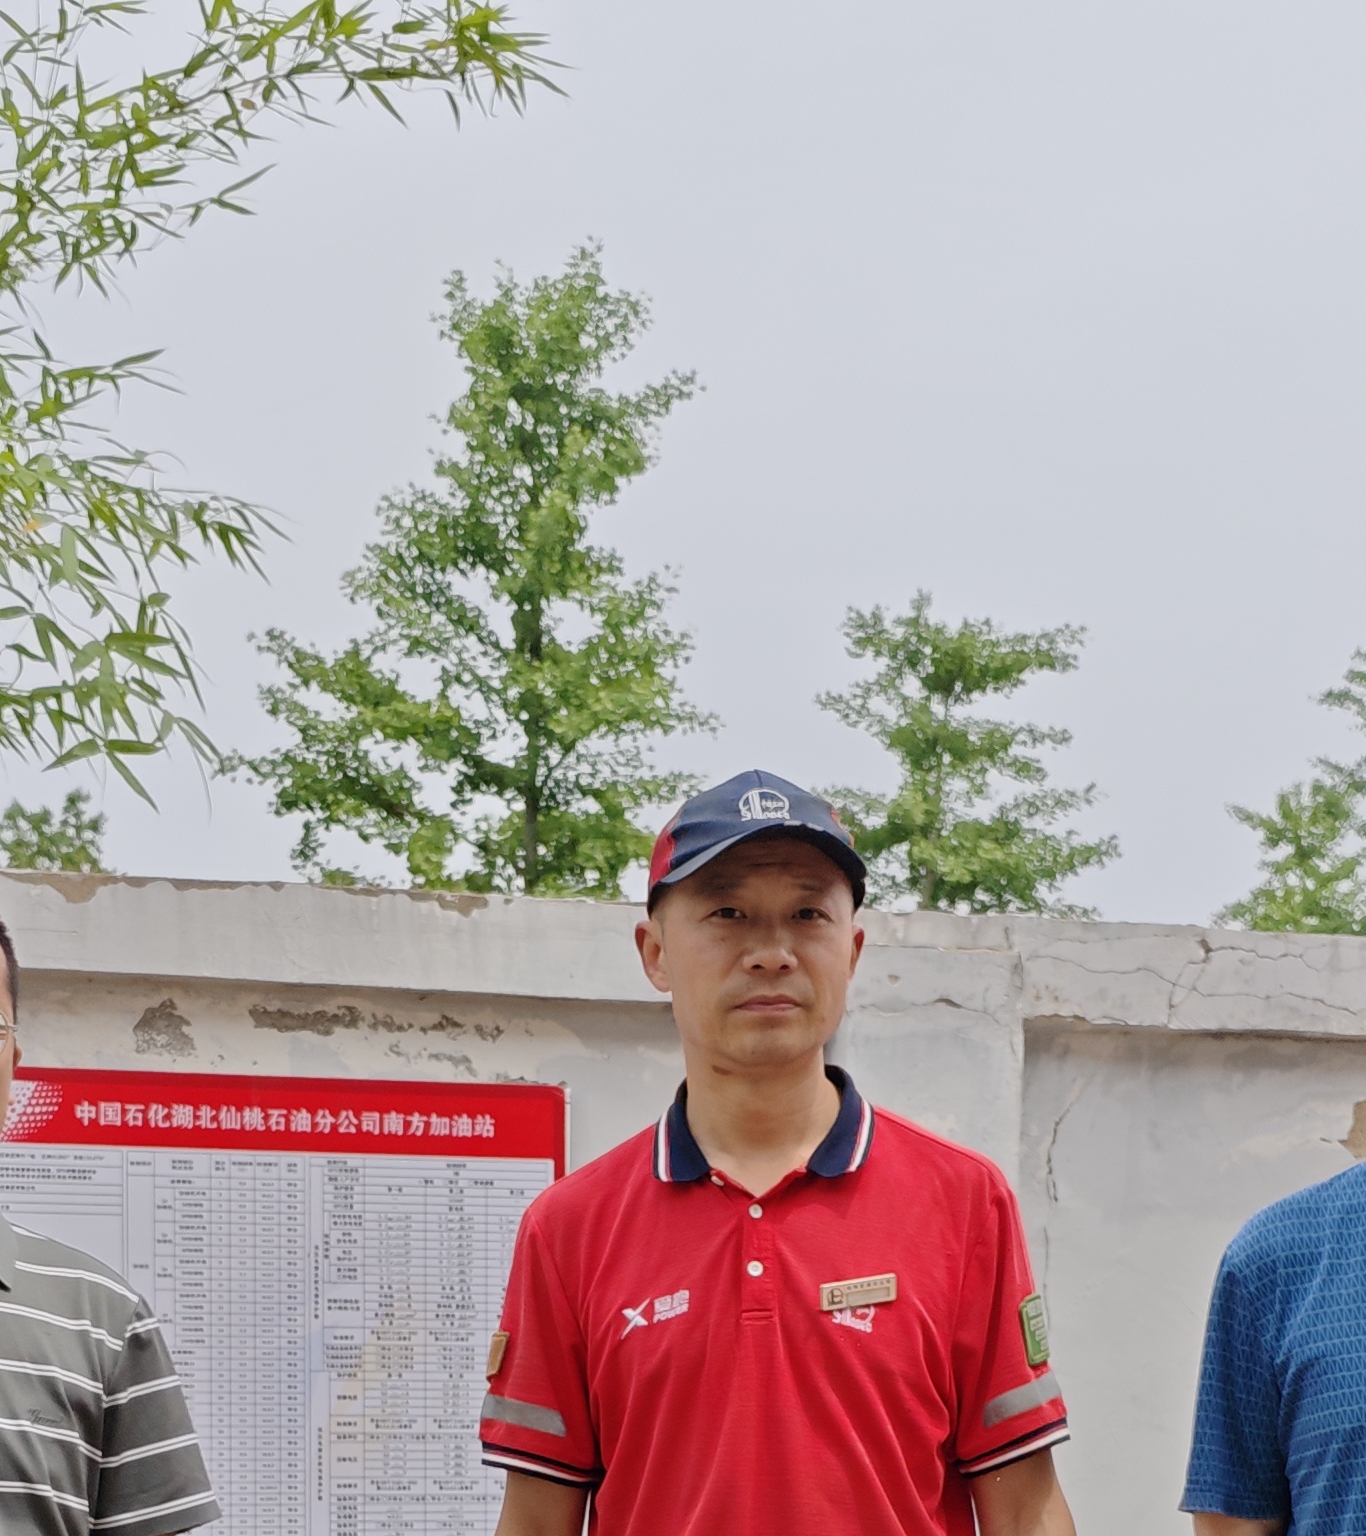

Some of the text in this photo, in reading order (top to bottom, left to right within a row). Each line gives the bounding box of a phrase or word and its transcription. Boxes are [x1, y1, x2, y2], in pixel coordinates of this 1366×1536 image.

[73, 1100, 497, 1140] 中国石化湖北仙桃石油分公司南方加油站
